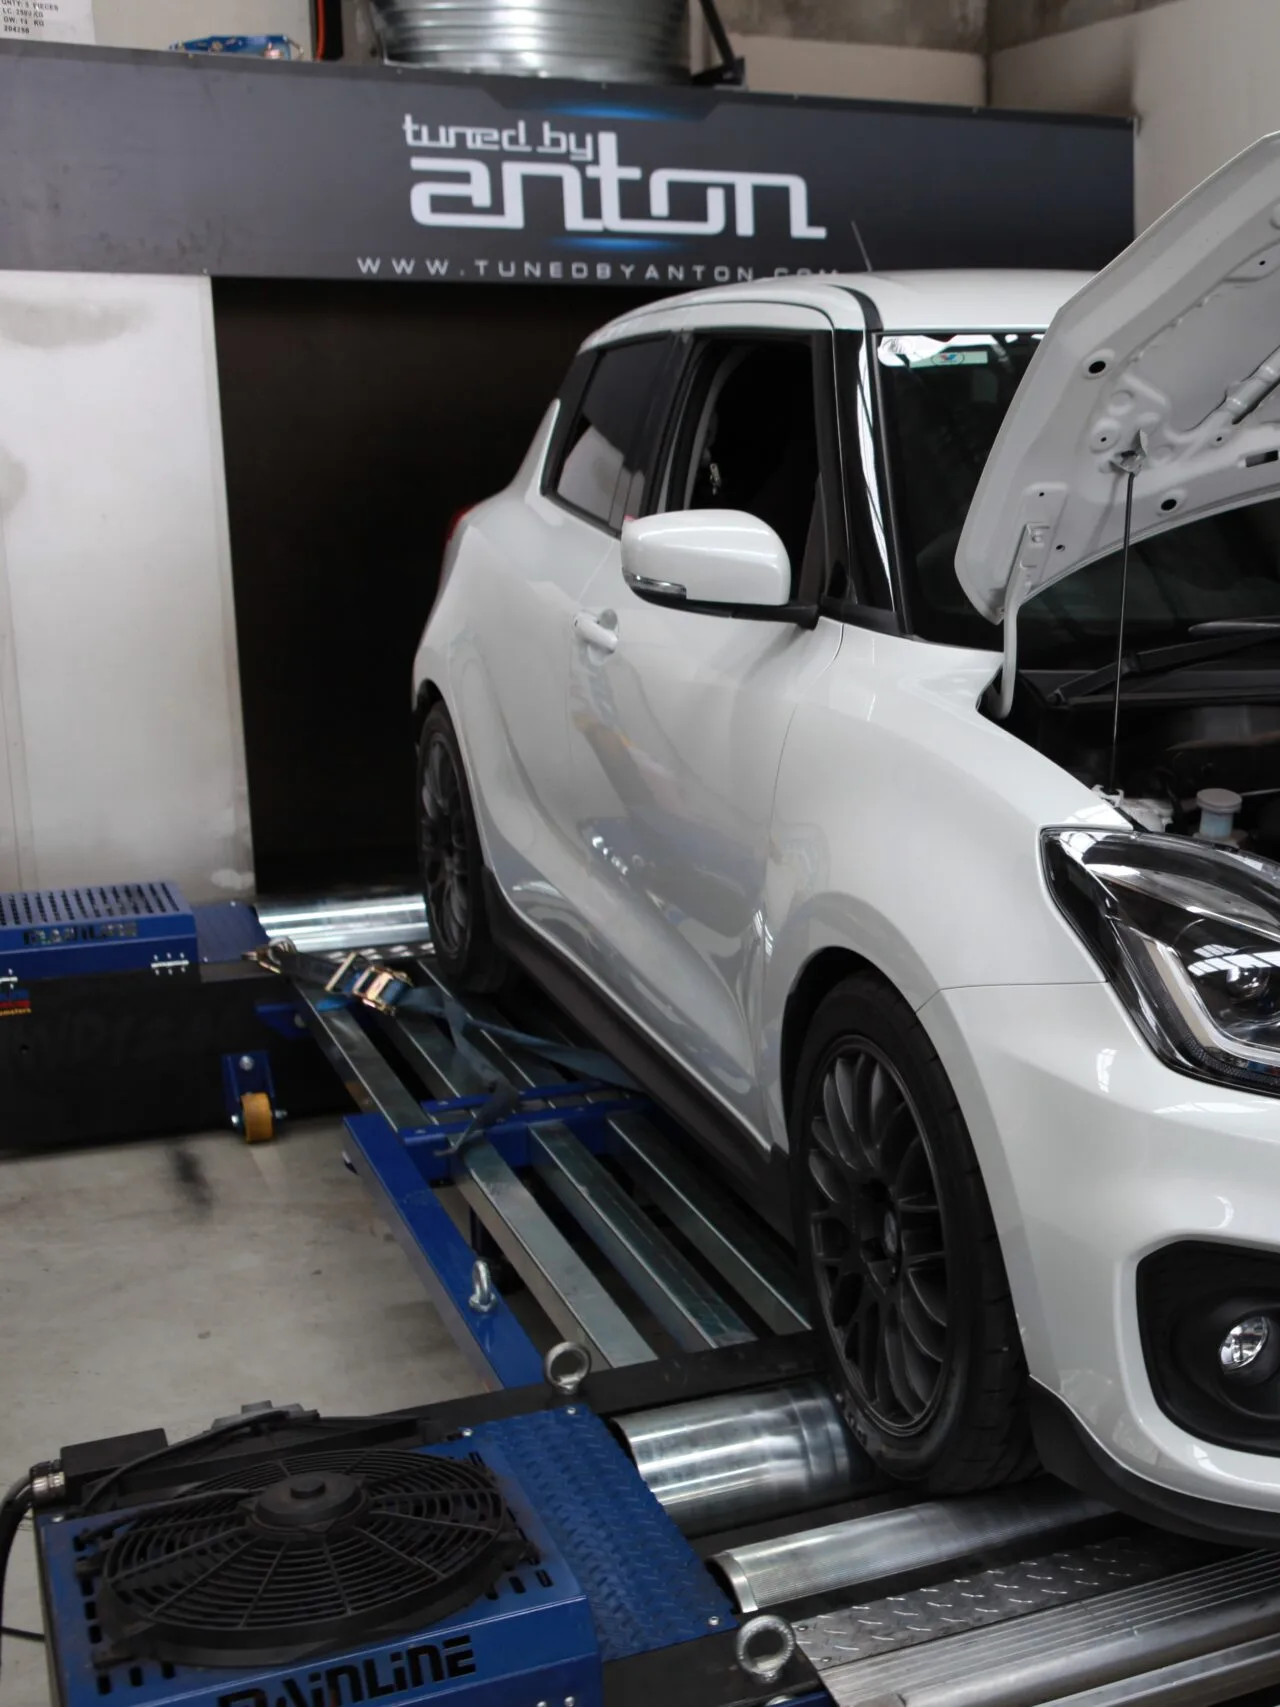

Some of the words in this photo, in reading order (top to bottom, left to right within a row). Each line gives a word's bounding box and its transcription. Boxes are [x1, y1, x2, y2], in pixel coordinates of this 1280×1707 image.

[403, 113, 532, 152] tuned
[537, 121, 594, 161] by
[410, 131, 827, 239] anton
